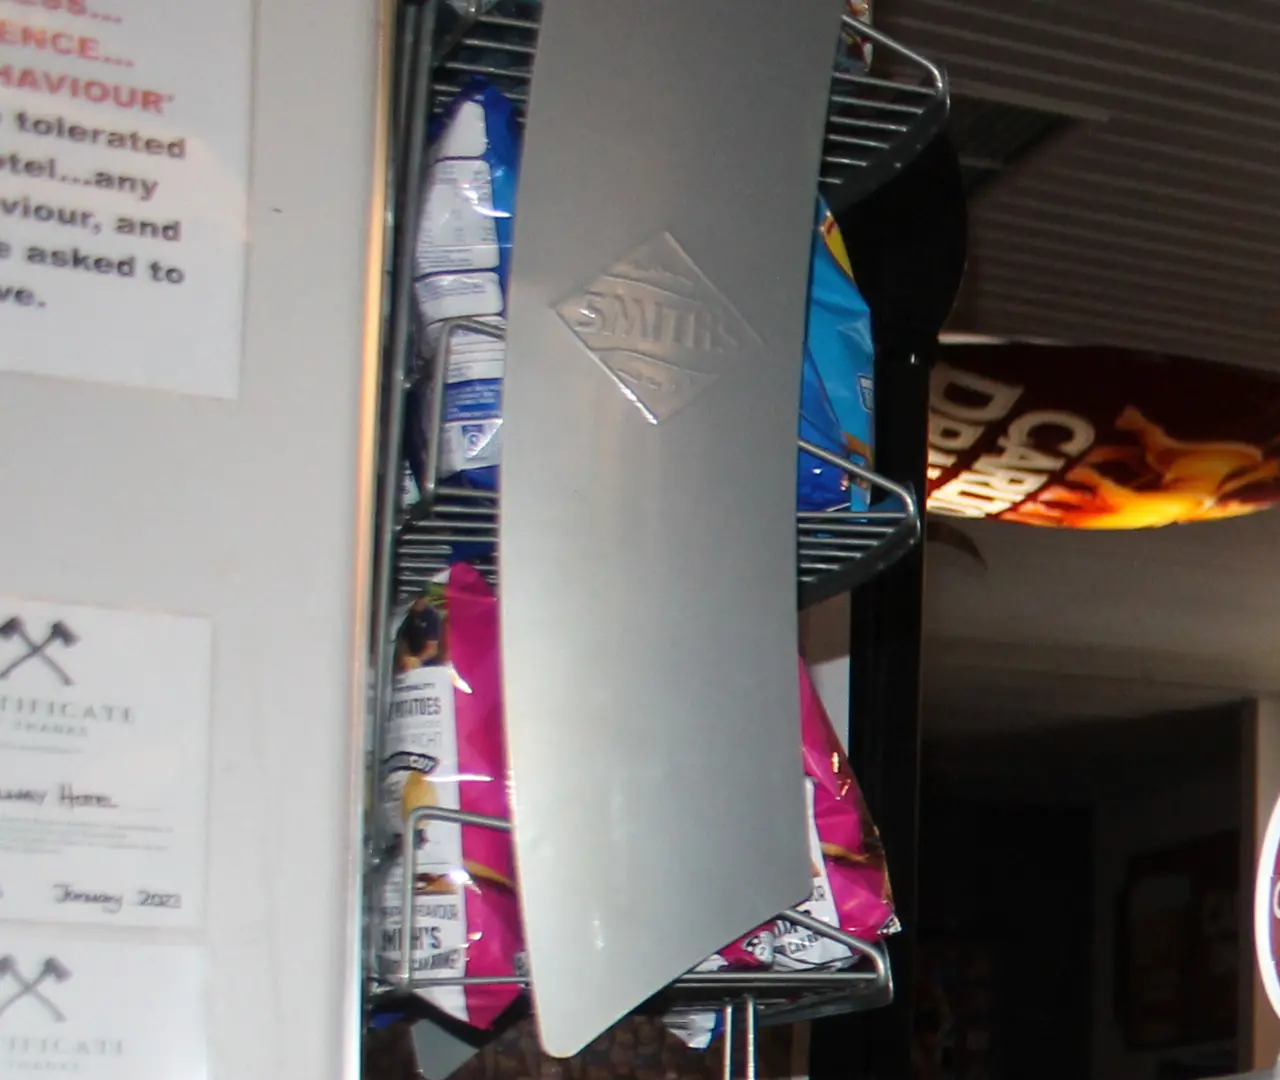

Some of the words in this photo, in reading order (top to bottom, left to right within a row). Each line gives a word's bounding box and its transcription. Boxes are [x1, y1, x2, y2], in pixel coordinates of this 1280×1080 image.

[16, 111, 187, 159] tolerated
[0, 197, 102, 236] viour,
[115, 217, 182, 242] and
[26, 246, 136, 278] asked
[149, 260, 186, 285] to
